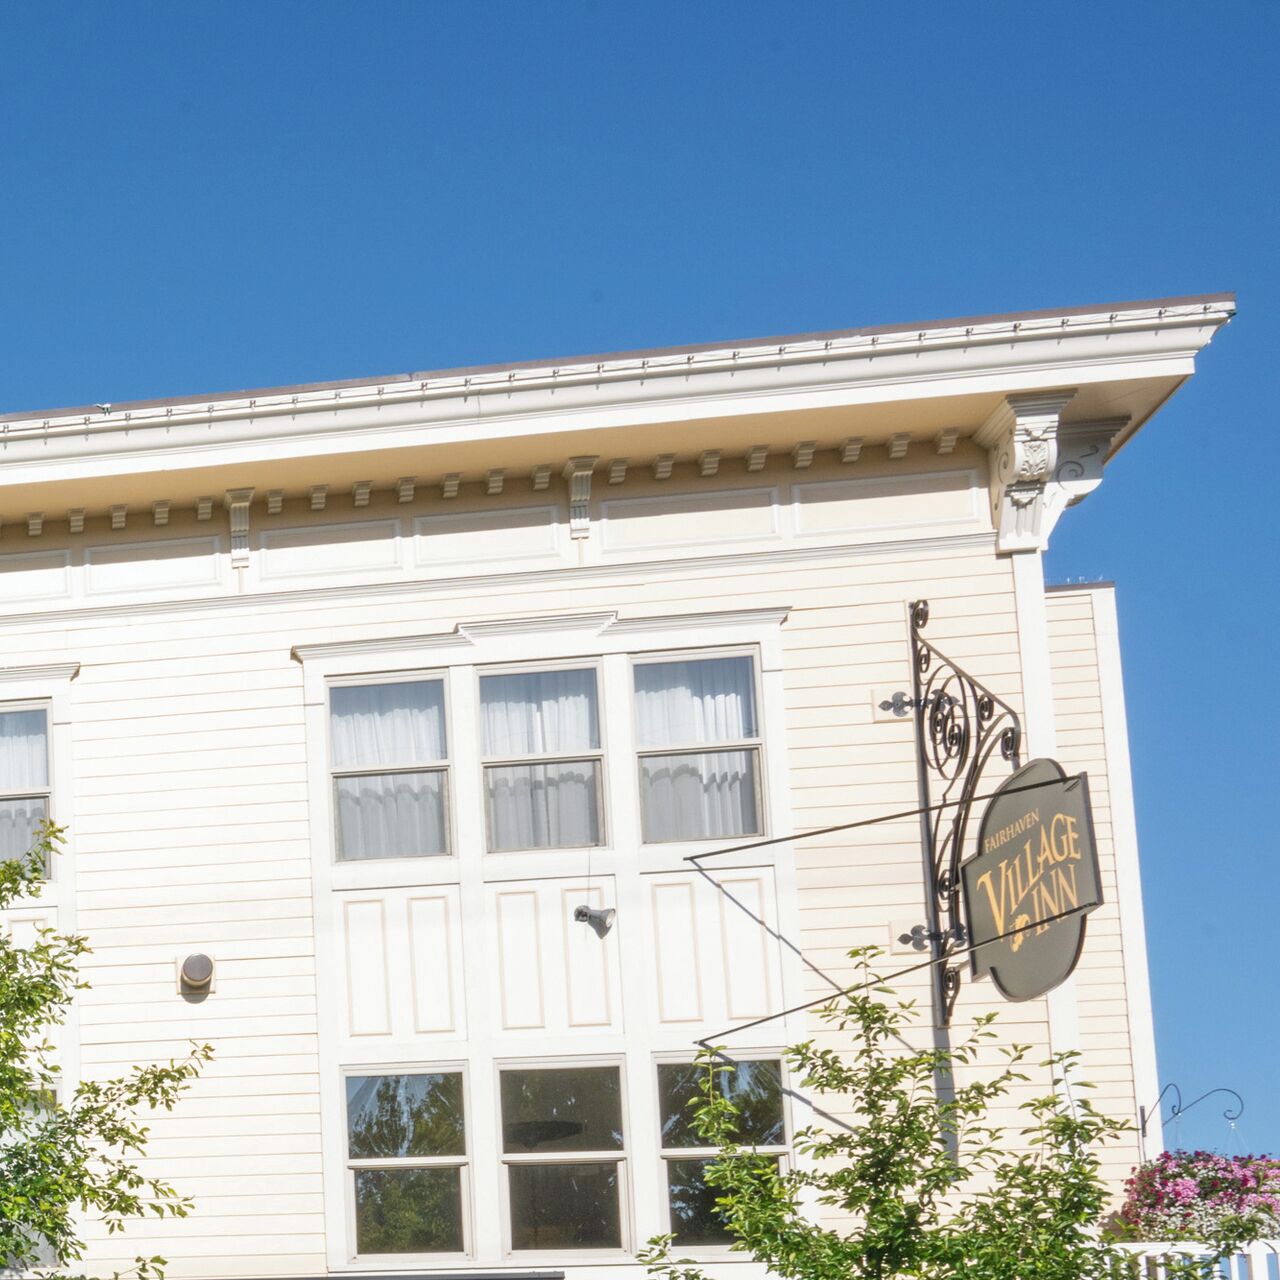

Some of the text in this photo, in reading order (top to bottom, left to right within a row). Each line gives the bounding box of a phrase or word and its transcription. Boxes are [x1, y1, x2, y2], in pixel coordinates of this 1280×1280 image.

[985, 808, 1040, 854] FAIRHAVEN
[976, 813, 1081, 943] VILLAGE
[1031, 863, 1079, 936] INN
